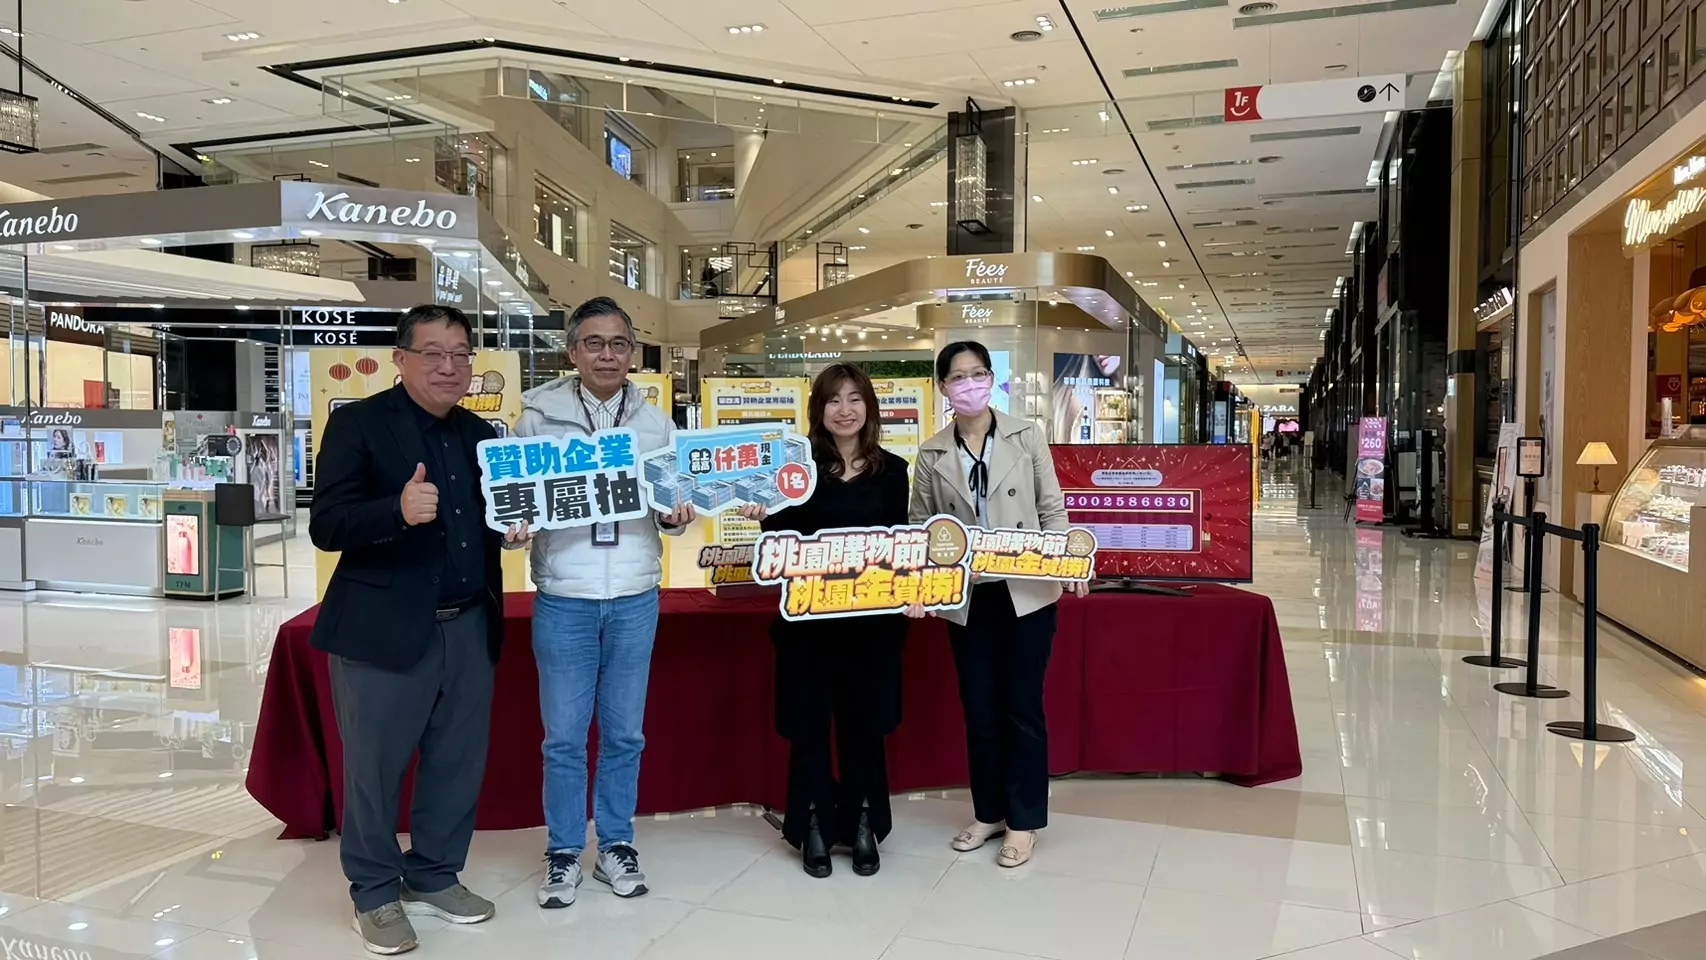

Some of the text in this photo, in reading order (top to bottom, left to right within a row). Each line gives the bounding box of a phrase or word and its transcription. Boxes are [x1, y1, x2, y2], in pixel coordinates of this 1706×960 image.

[1234, 91, 1249, 107] 1F
[307, 191, 457, 229] Kanebo
[966, 258, 1009, 277] Fées
[961, 303, 993, 318] Fées
[314, 330, 358, 345] KOSÉ
[21, 411, 82, 425] Kanebo
[485, 434, 634, 481] 贊助企業
[714, 443, 759, 471] 仟萬
[761, 443, 771, 465] 現金
[782, 471, 805, 489] 1名
[490, 470, 643, 526] 專屬抽
[1066, 496, 1189, 507] 2002586630
[760, 531, 928, 578] 桃園購物節
[788, 565, 963, 614] 桃園金賀勝!
